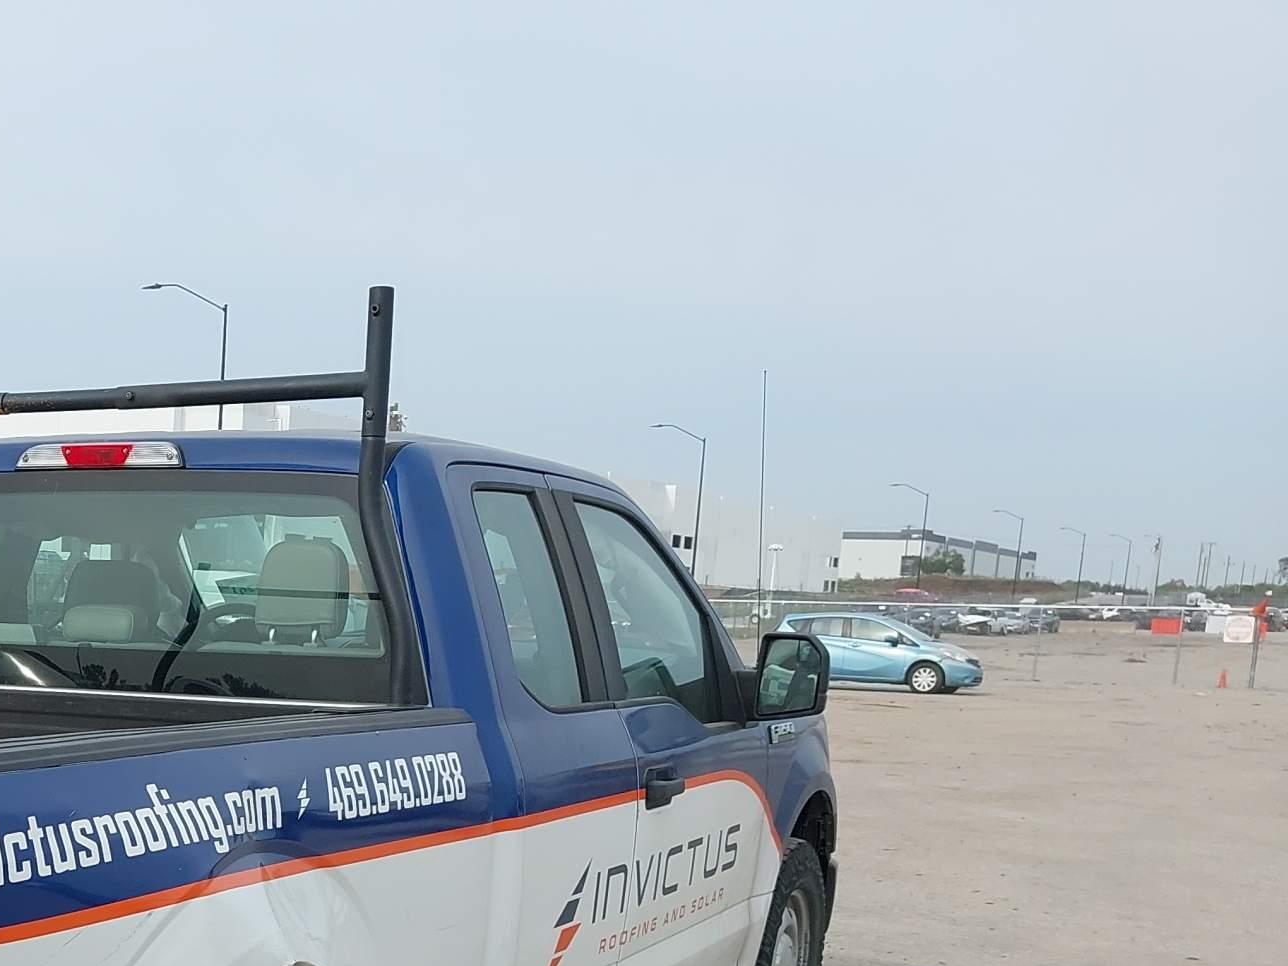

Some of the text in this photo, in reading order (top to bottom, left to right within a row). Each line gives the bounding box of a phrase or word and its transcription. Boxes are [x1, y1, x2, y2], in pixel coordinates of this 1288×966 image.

[325, 752, 466, 821] 469.649.0288
[592, 824, 742, 924] INVICTUS
[598, 887, 725, 954] ROOFING AND SOLAR
